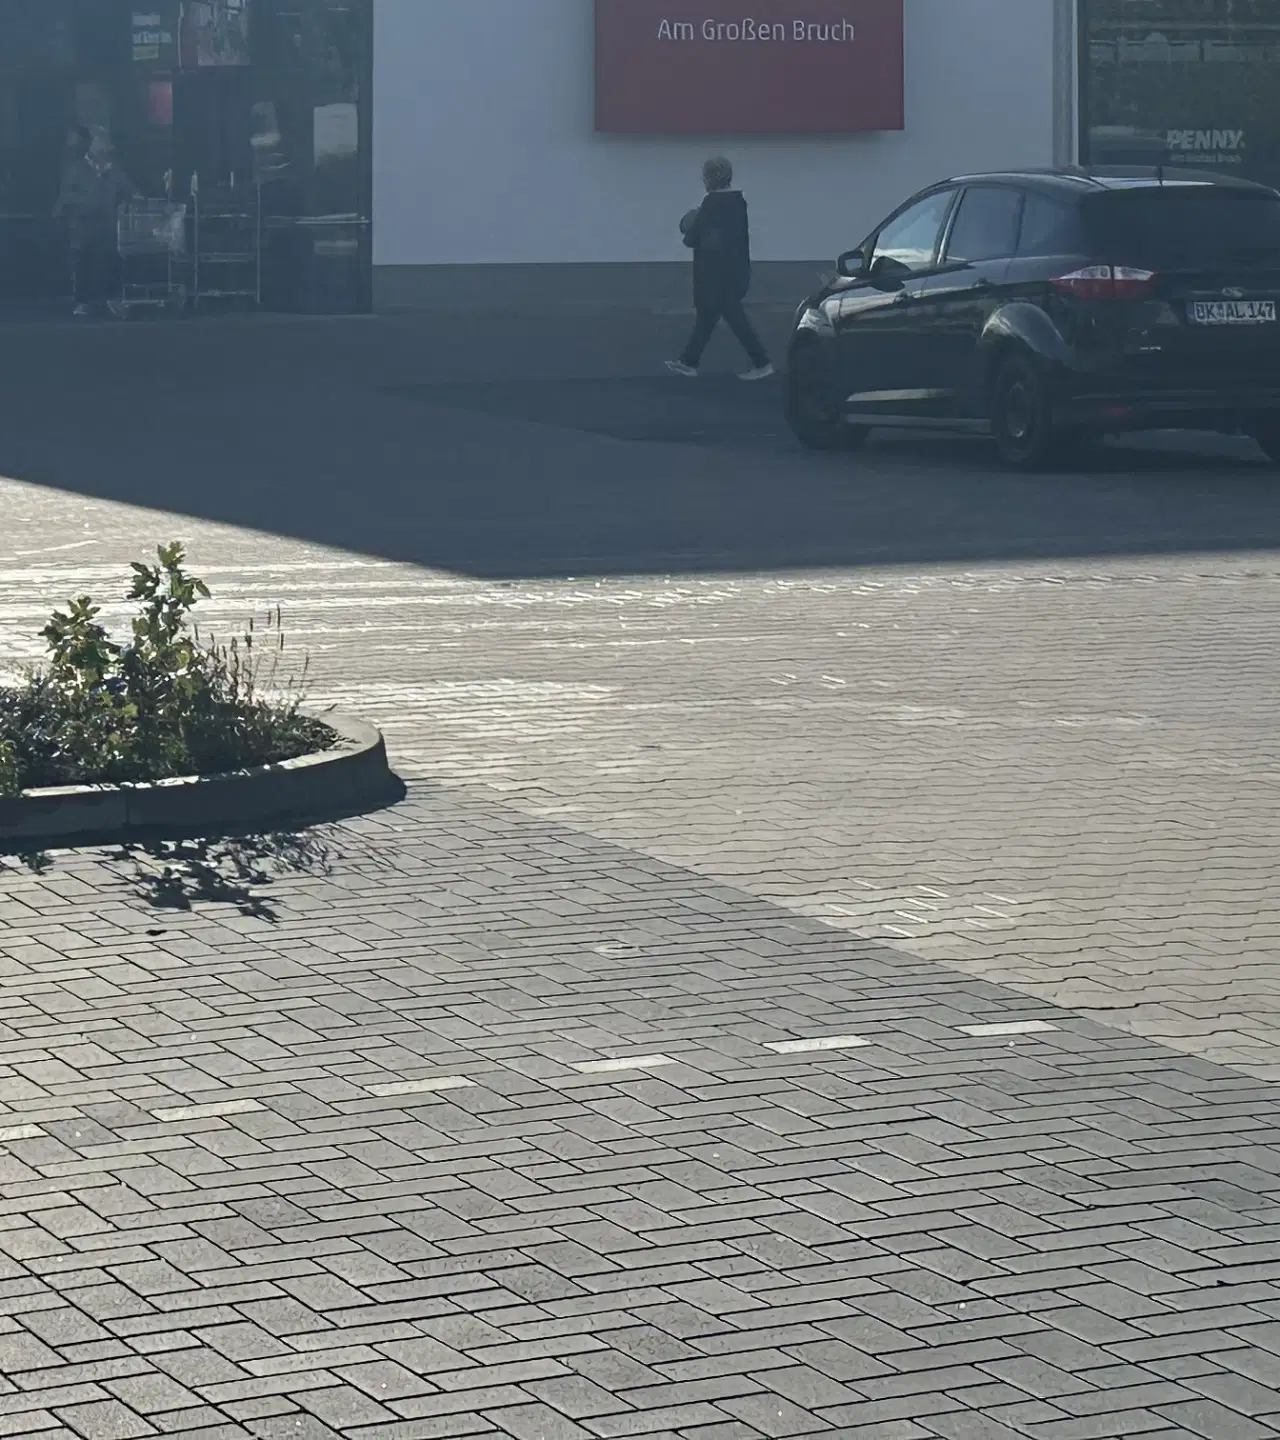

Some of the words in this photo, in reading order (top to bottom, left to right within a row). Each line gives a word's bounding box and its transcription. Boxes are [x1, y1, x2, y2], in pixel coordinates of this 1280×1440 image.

[657, 19, 694, 41] Am
[702, 18, 785, 42] Großen
[793, 18, 855, 42] Bruch
